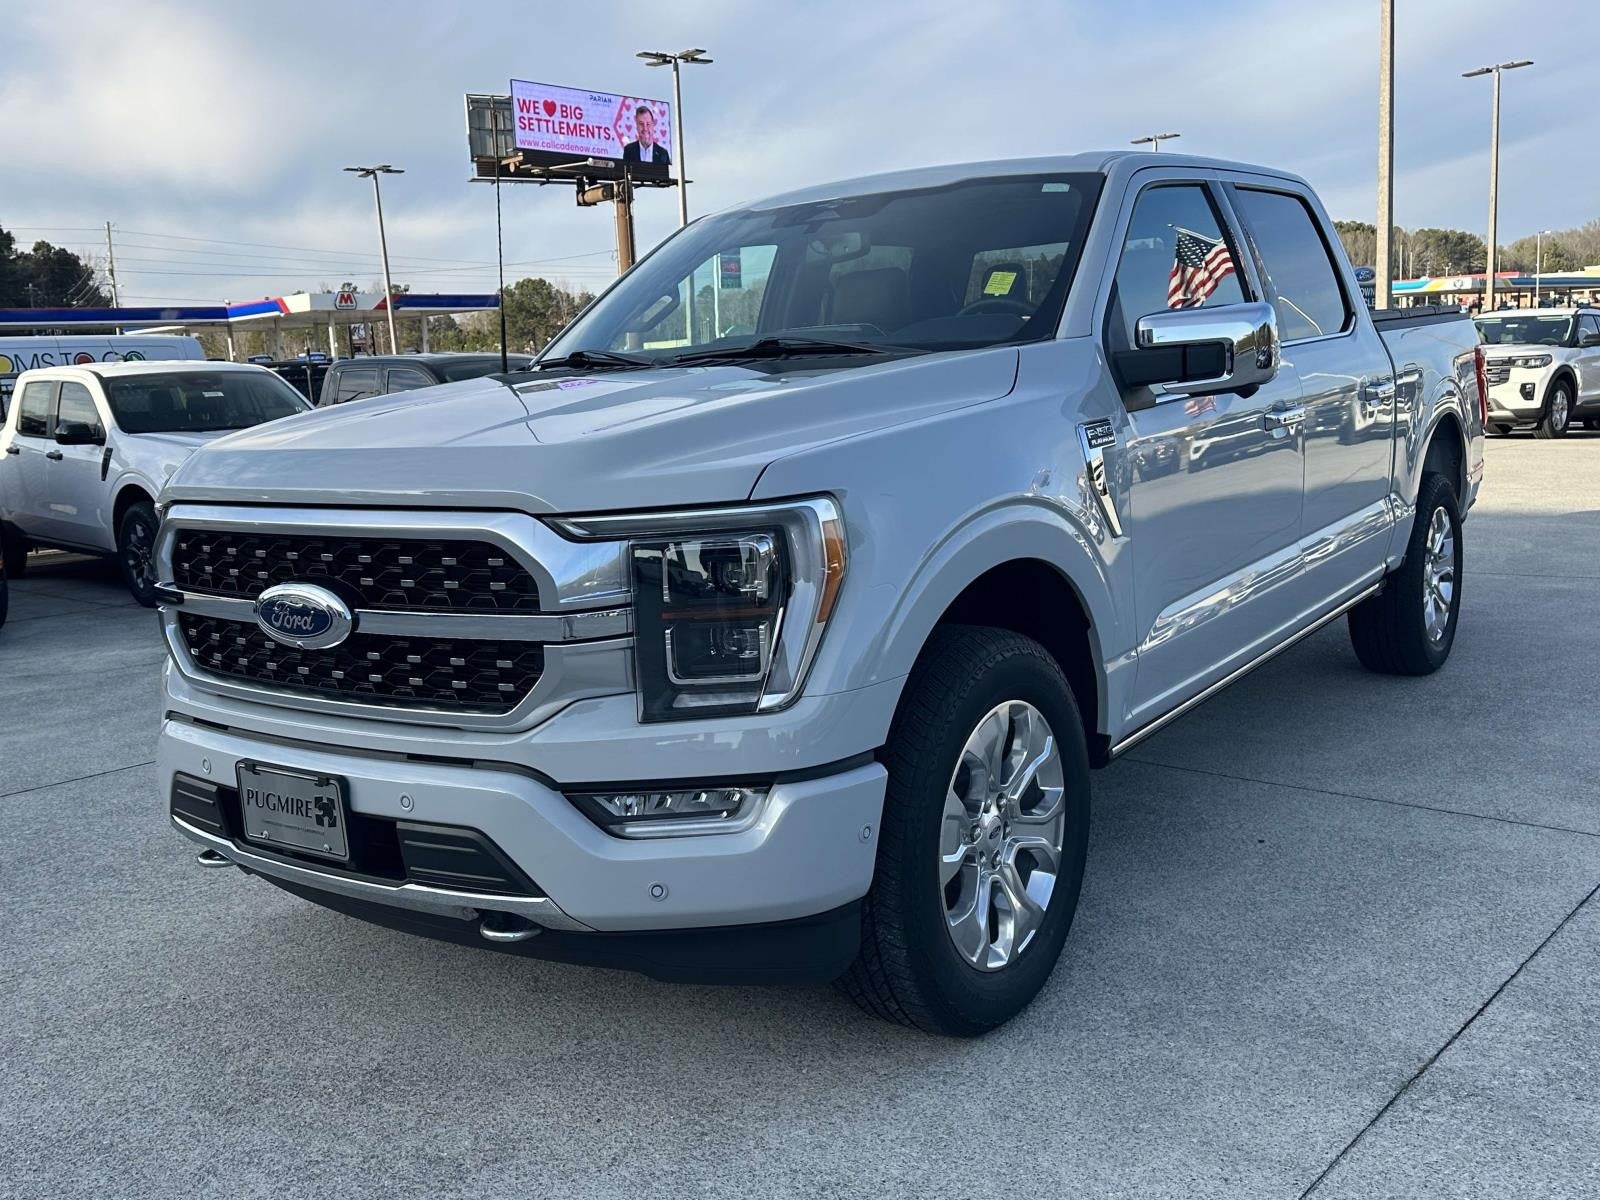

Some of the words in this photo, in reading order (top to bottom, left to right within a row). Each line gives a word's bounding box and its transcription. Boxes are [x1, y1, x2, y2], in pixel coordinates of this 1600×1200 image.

[517, 98, 540, 115] WE
[561, 104, 583, 120] BIG
[589, 94, 612, 104] PARIAN
[518, 116, 615, 141] SETTLEMENTS.
[519, 138, 609, 155] www.callcadenow.com
[1091, 436, 1115, 446] PLATINUM
[271, 600, 315, 631] Ford
[246, 787, 313, 819] PUGMIRE
